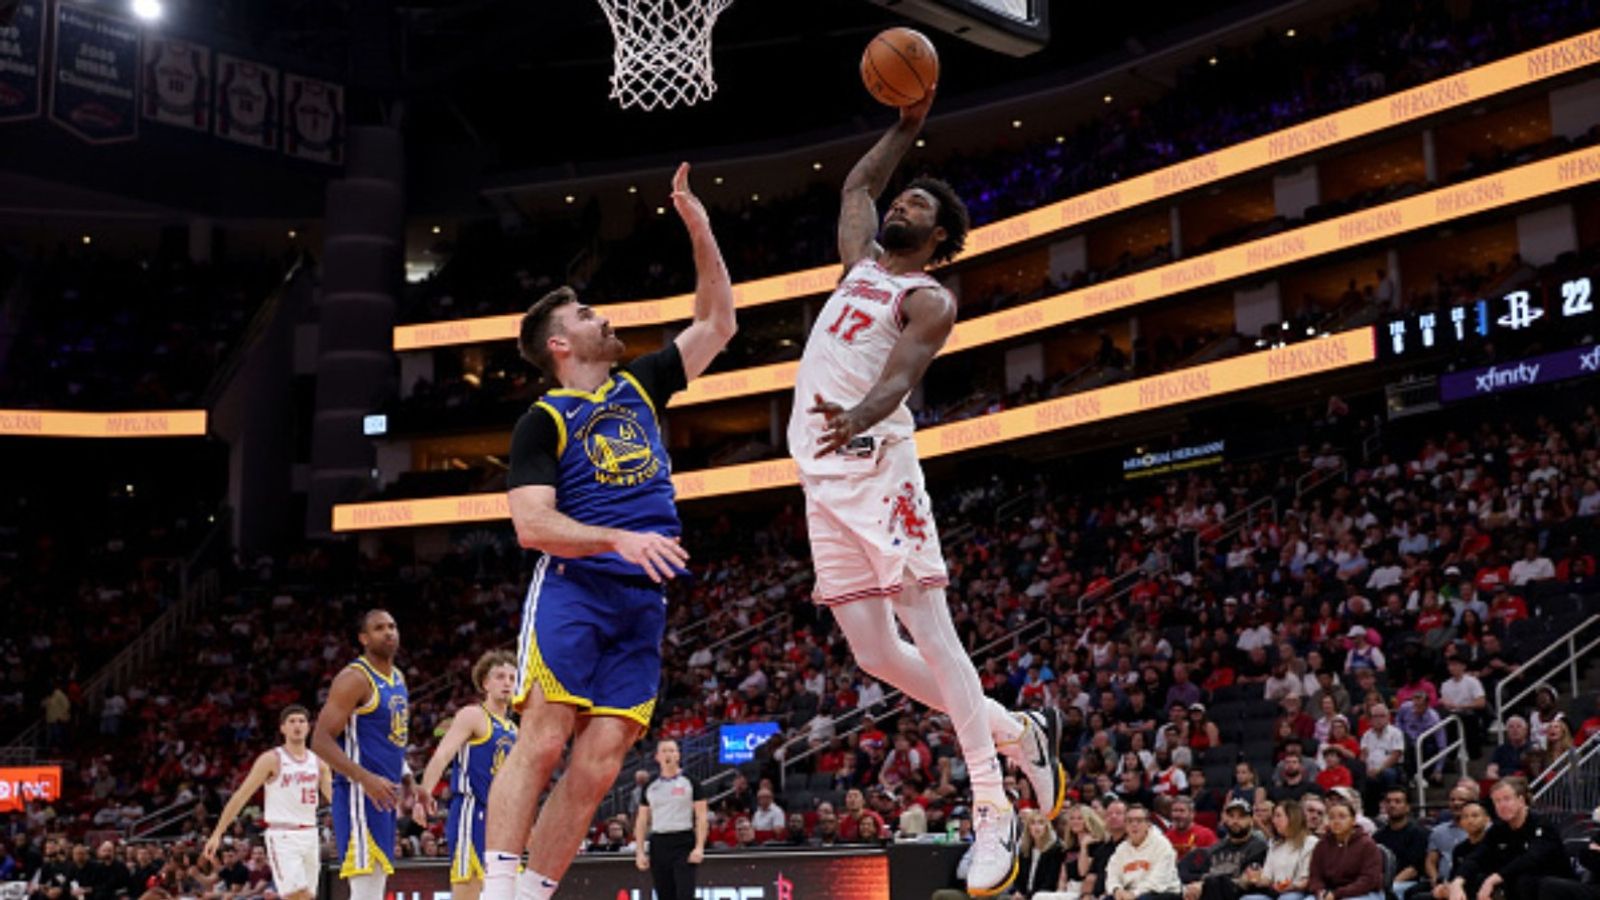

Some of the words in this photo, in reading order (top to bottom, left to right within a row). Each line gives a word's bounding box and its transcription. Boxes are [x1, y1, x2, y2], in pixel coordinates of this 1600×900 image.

[1562, 278, 1593, 316] 22
[827, 303, 873, 343] 17
[1475, 363, 1540, 392] xfinity
